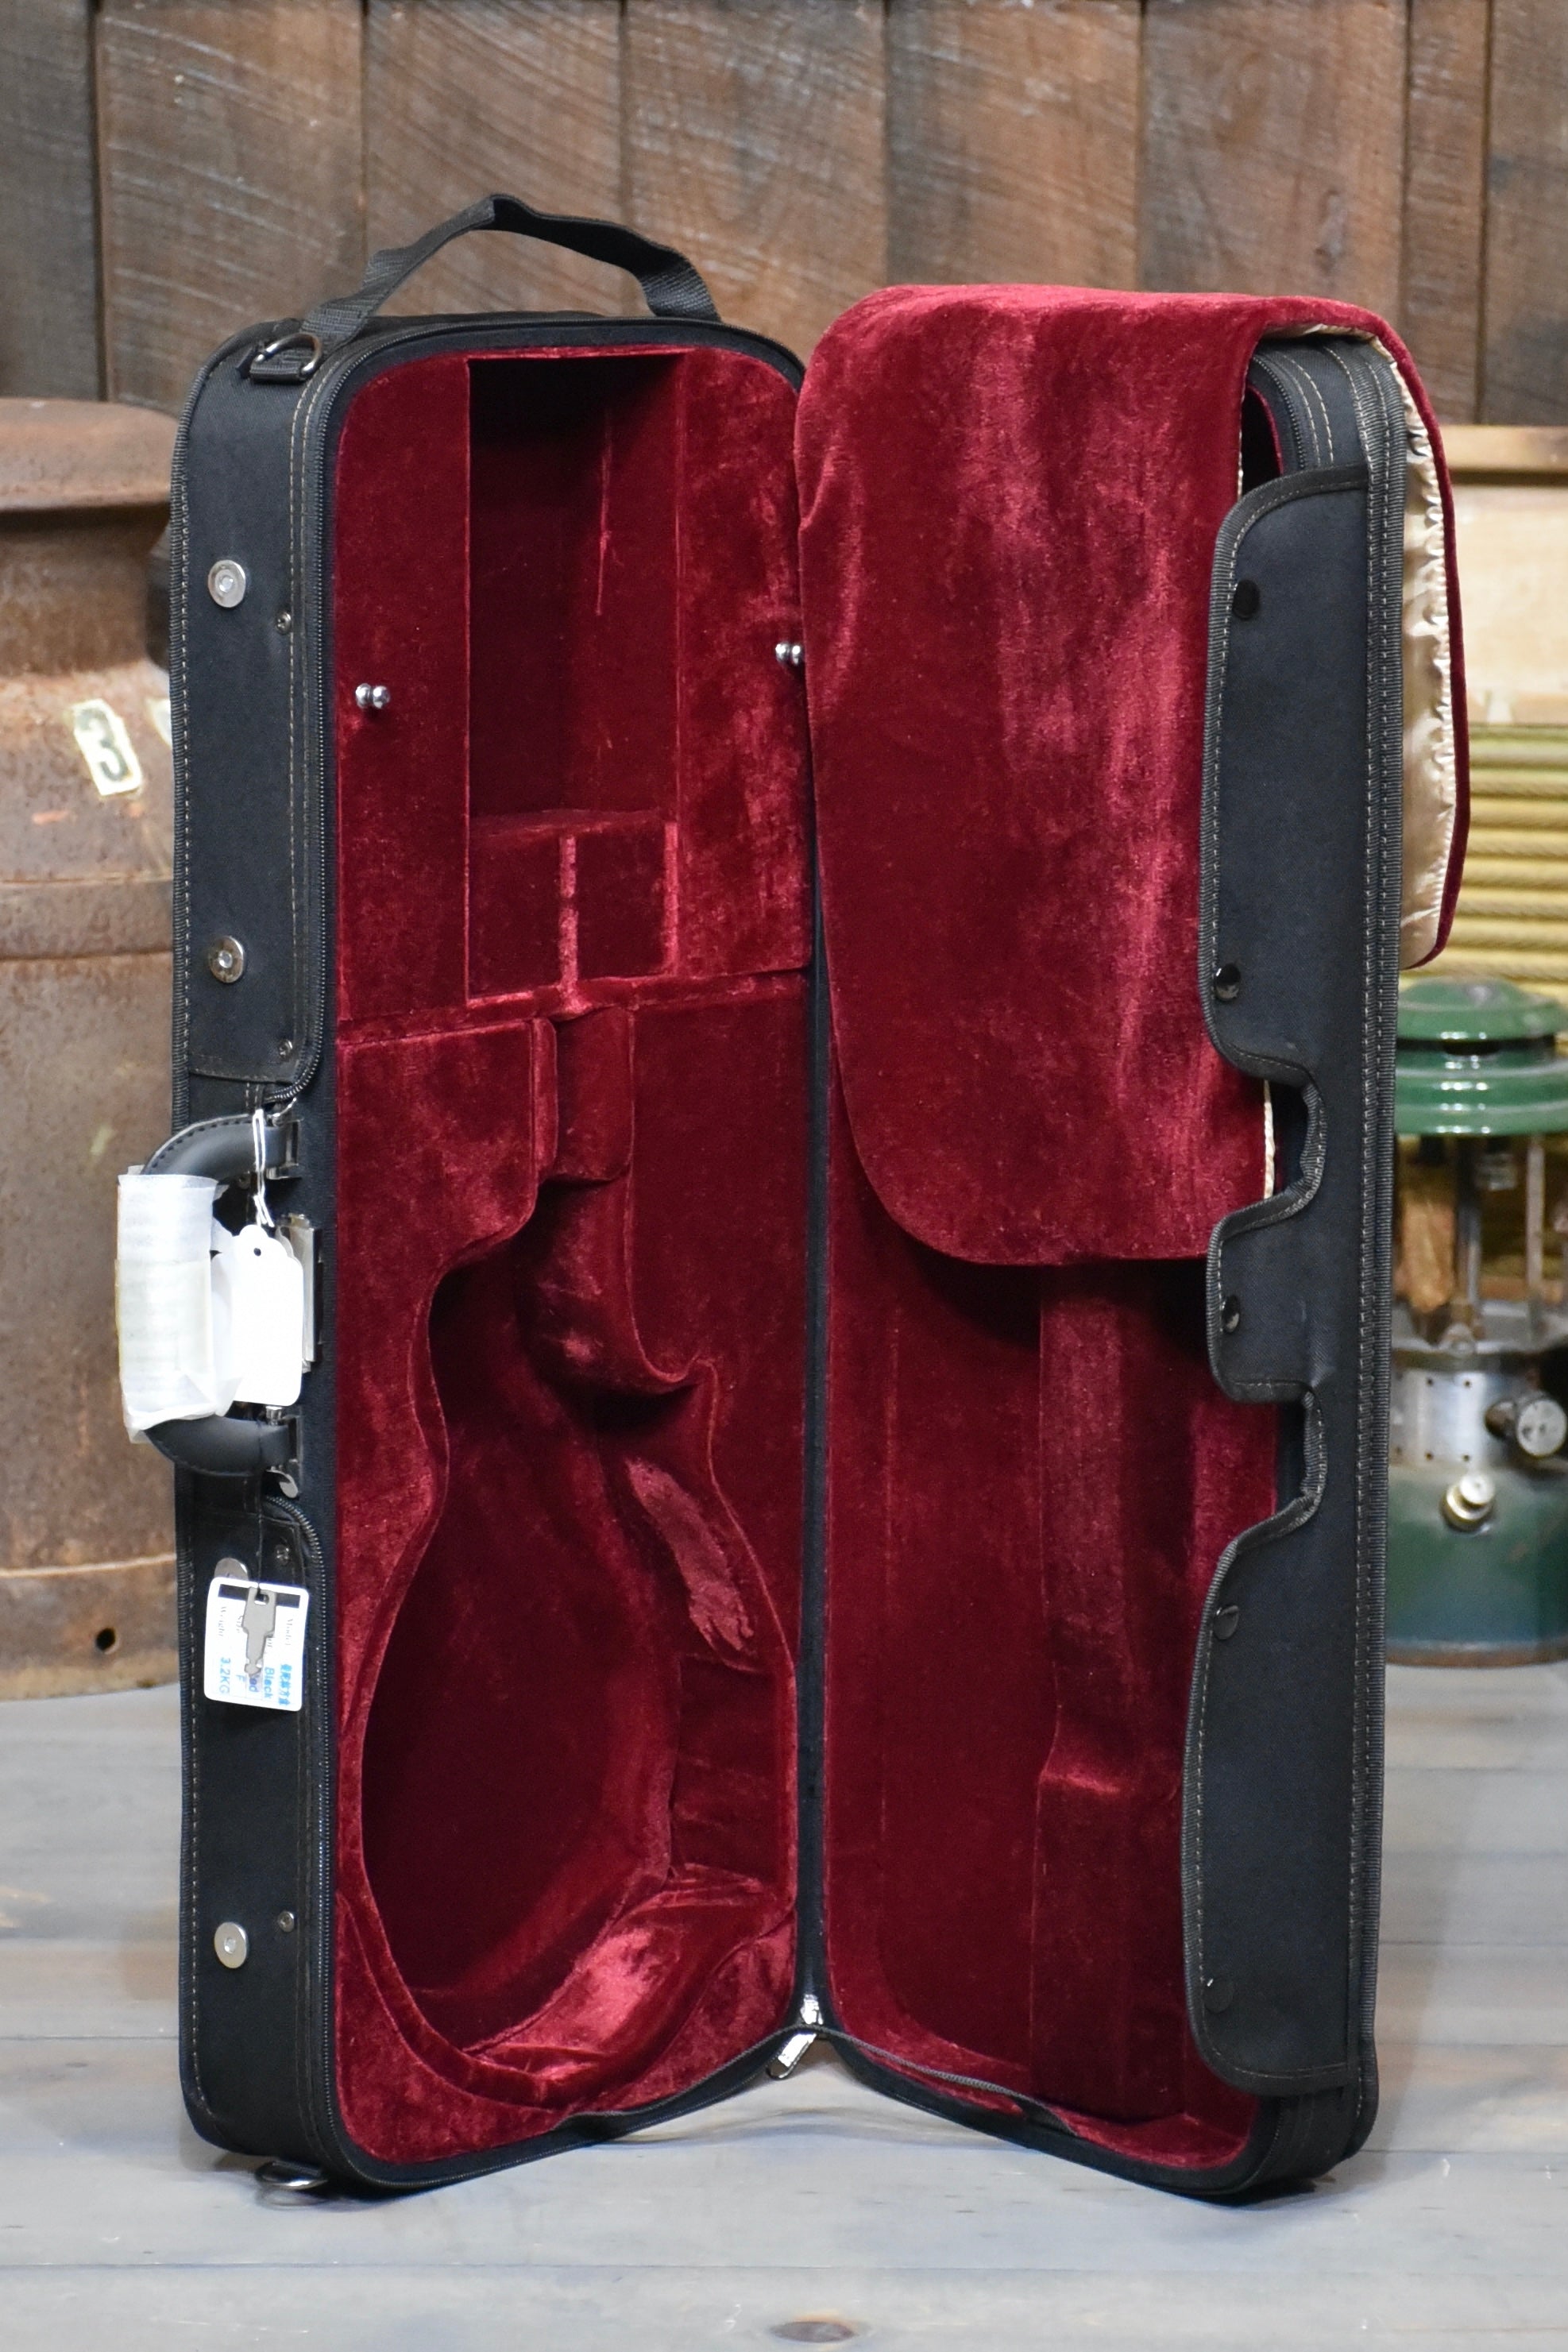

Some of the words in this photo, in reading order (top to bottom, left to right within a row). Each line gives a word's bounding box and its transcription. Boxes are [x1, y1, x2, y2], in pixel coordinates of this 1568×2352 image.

[77, 709, 127, 781] 3
[219, 1657, 231, 1694] 3.2KG
[265, 1667, 275, 1698] Black
